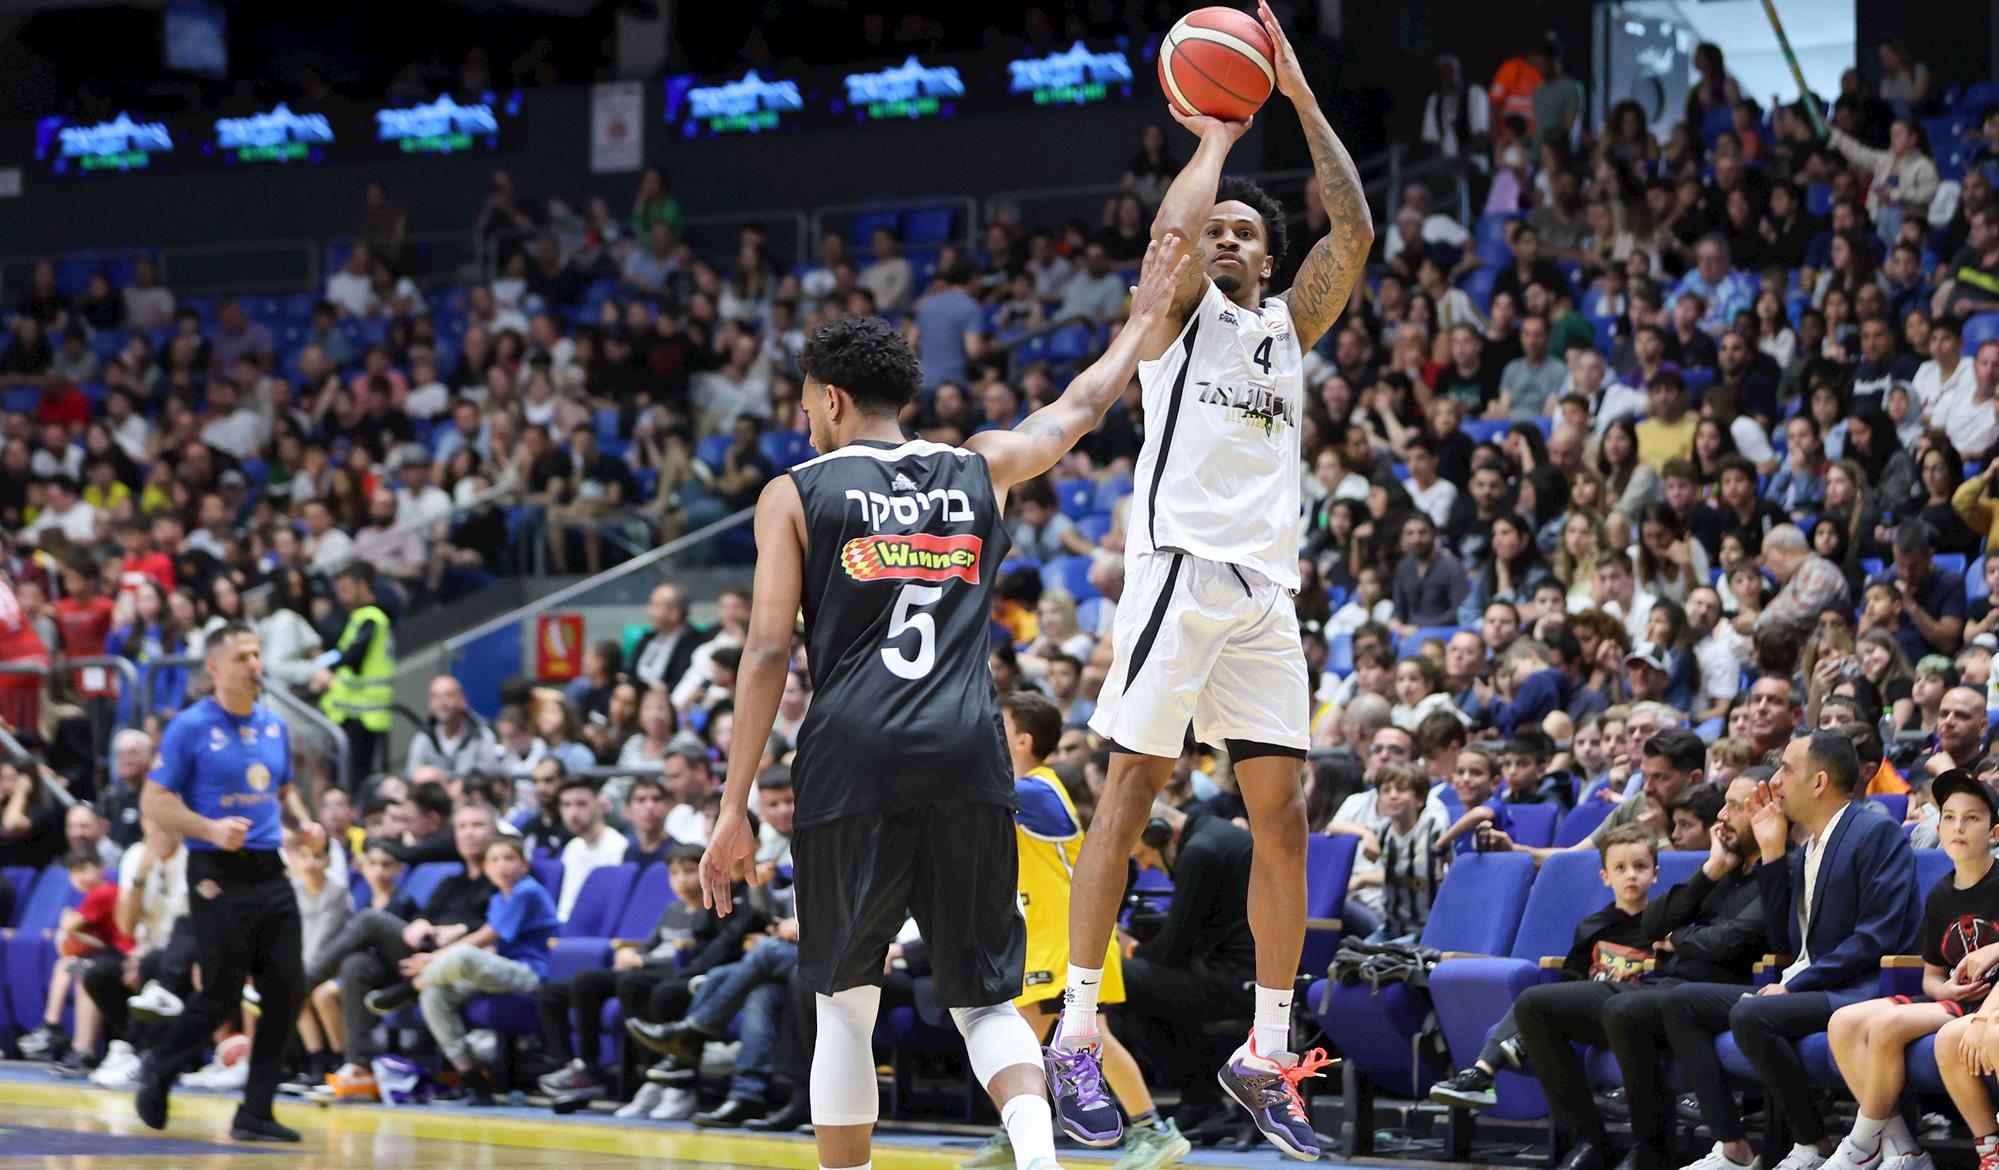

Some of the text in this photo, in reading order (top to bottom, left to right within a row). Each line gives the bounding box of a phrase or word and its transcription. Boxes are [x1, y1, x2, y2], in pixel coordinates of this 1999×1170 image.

[1253, 336, 1274, 375] 4
[845, 488, 976, 531] בריסקר
[874, 540, 976, 573] Winner
[880, 583, 943, 680] 5
